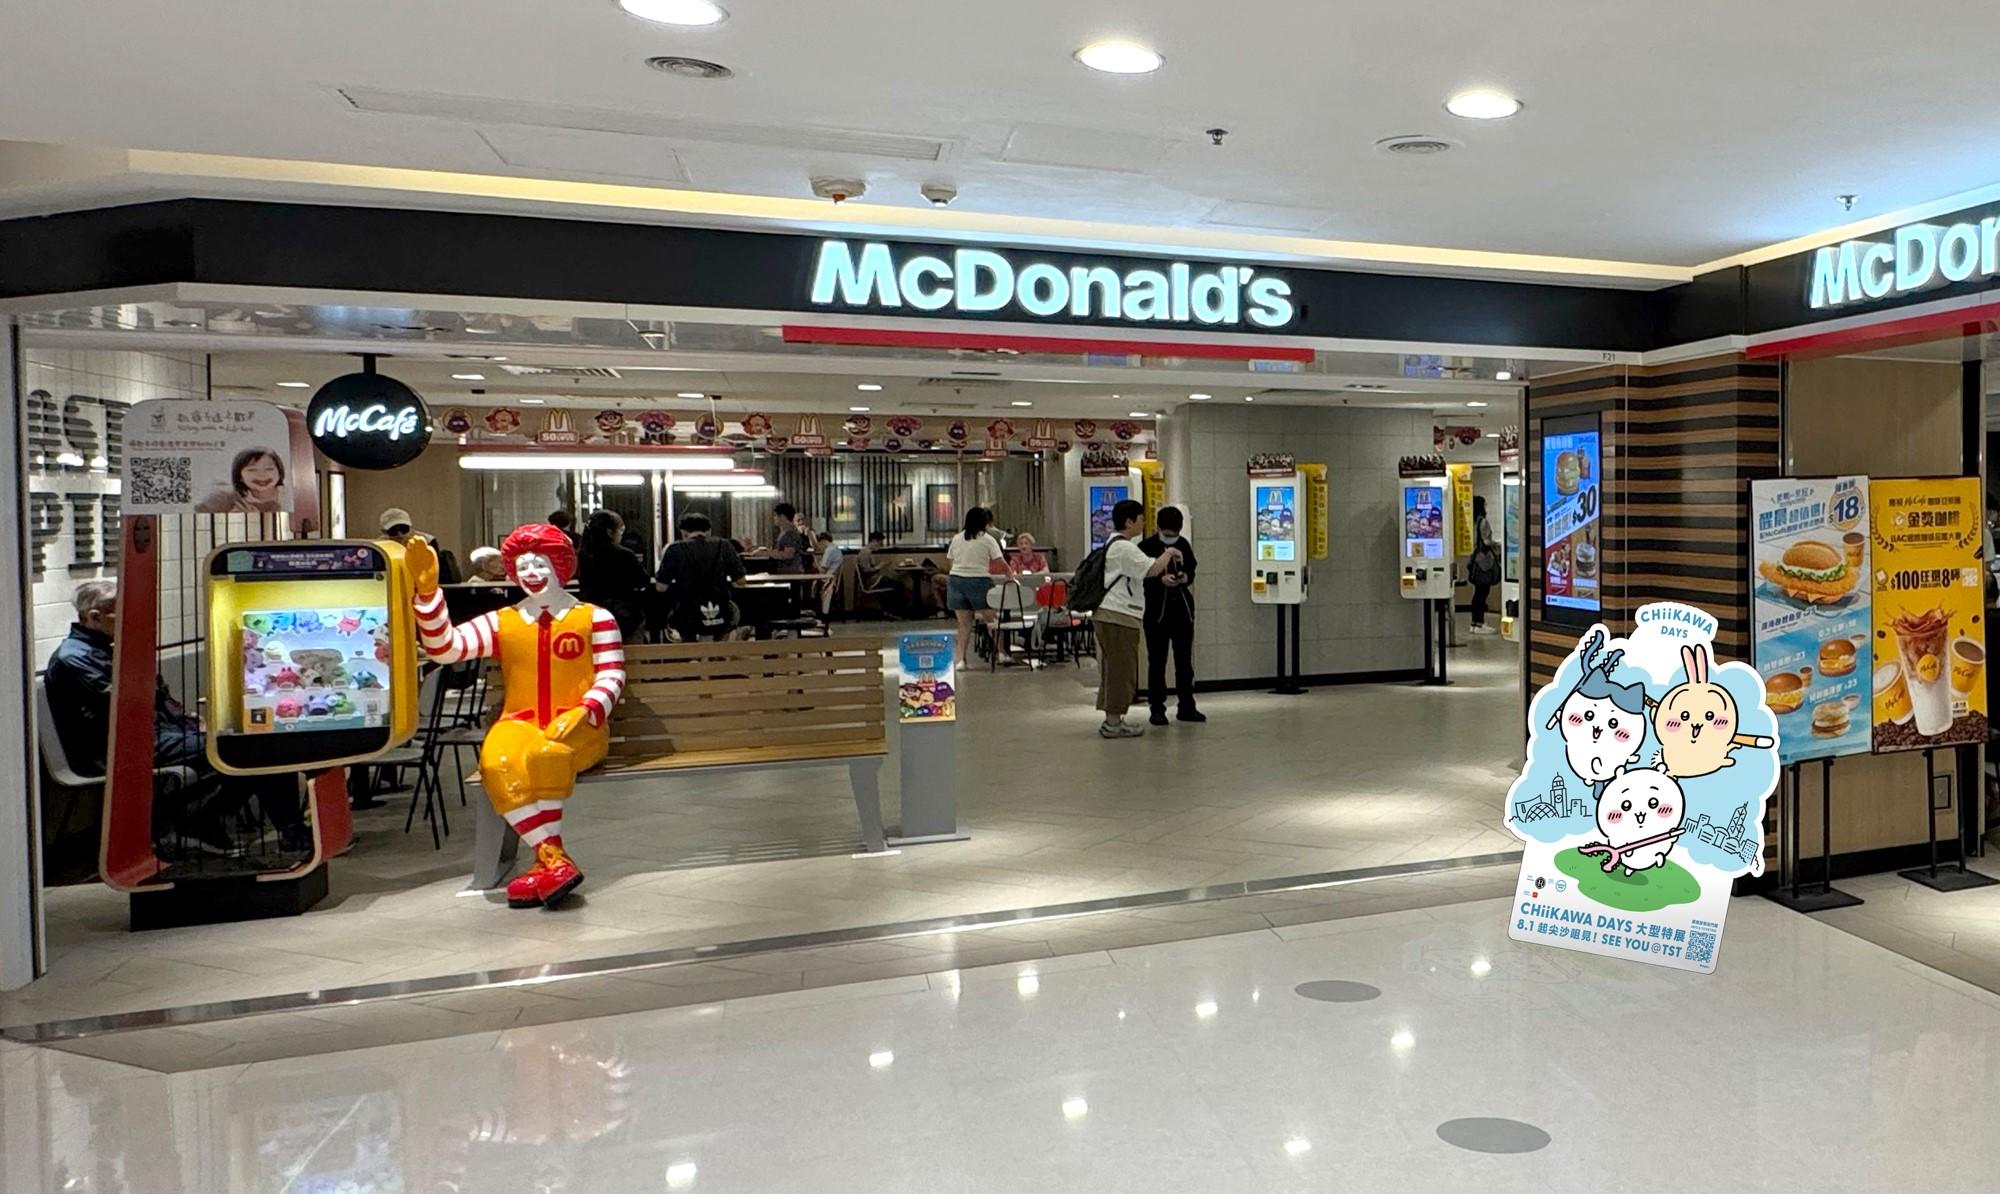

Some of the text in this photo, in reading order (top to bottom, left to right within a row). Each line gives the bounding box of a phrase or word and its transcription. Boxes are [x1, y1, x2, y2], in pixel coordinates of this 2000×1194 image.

[811, 239, 1296, 328] McDonald's
[314, 404, 418, 441] McCafé
[1572, 485, 1597, 526] $30
[1641, 608, 1713, 635] CHiiKAWA
[1661, 625, 1688, 638] DAYS
[1517, 919, 1534, 931] 8.1
[1601, 934, 1622, 947] SEE
[1520, 902, 1686, 943] CHiiKAWA DAYS 大型特展
